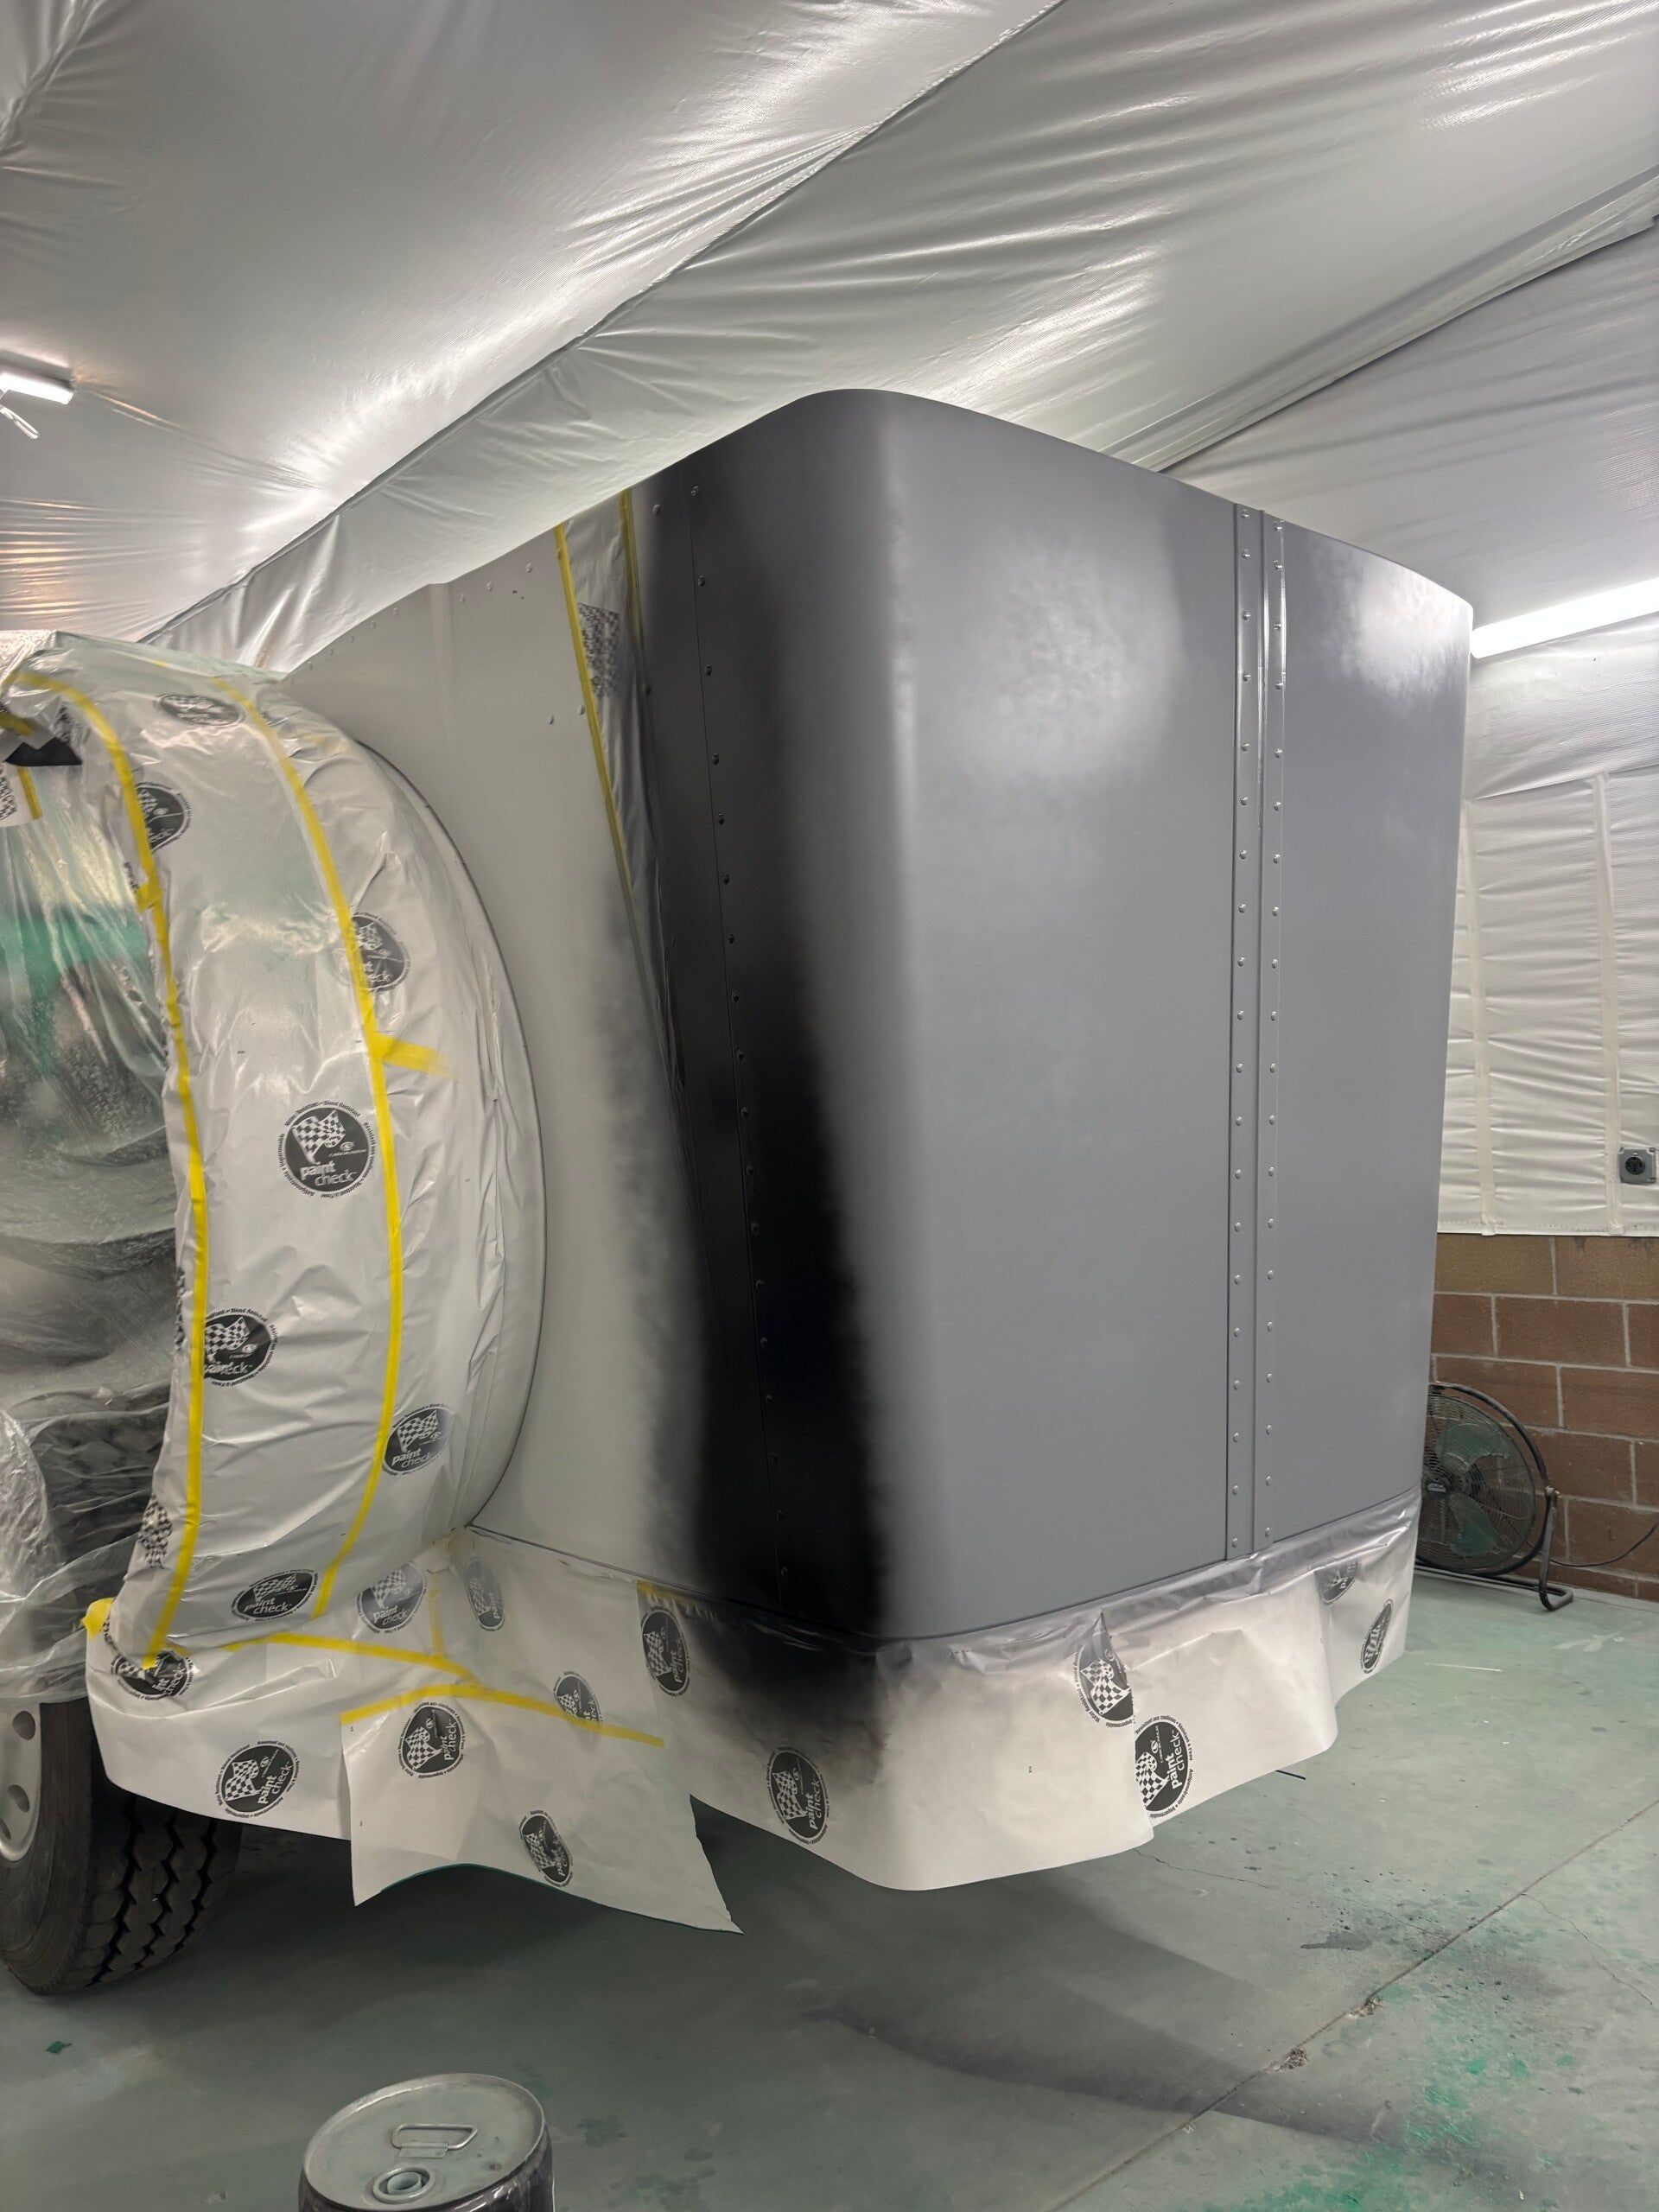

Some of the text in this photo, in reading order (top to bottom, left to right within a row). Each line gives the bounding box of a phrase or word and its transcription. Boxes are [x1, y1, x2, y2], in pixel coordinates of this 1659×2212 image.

[300, 1160, 337, 1181] paint
[315, 1169, 357, 1186] check
[391, 1447, 422, 1466] paint
[244, 1597, 276, 1612] paint
[253, 1601, 289, 1614] check
[373, 1605, 398, 1624] paint
[440, 1736, 454, 1761] paint
[445, 1721, 457, 1752] check
[1170, 1732, 1185, 1771] check
[271, 1763, 294, 1795] check
[1165, 1752, 1183, 1789] paint
[257, 1775, 277, 1804] paint
[811, 1780, 823, 1819] check
[806, 1793, 819, 1830] paint
